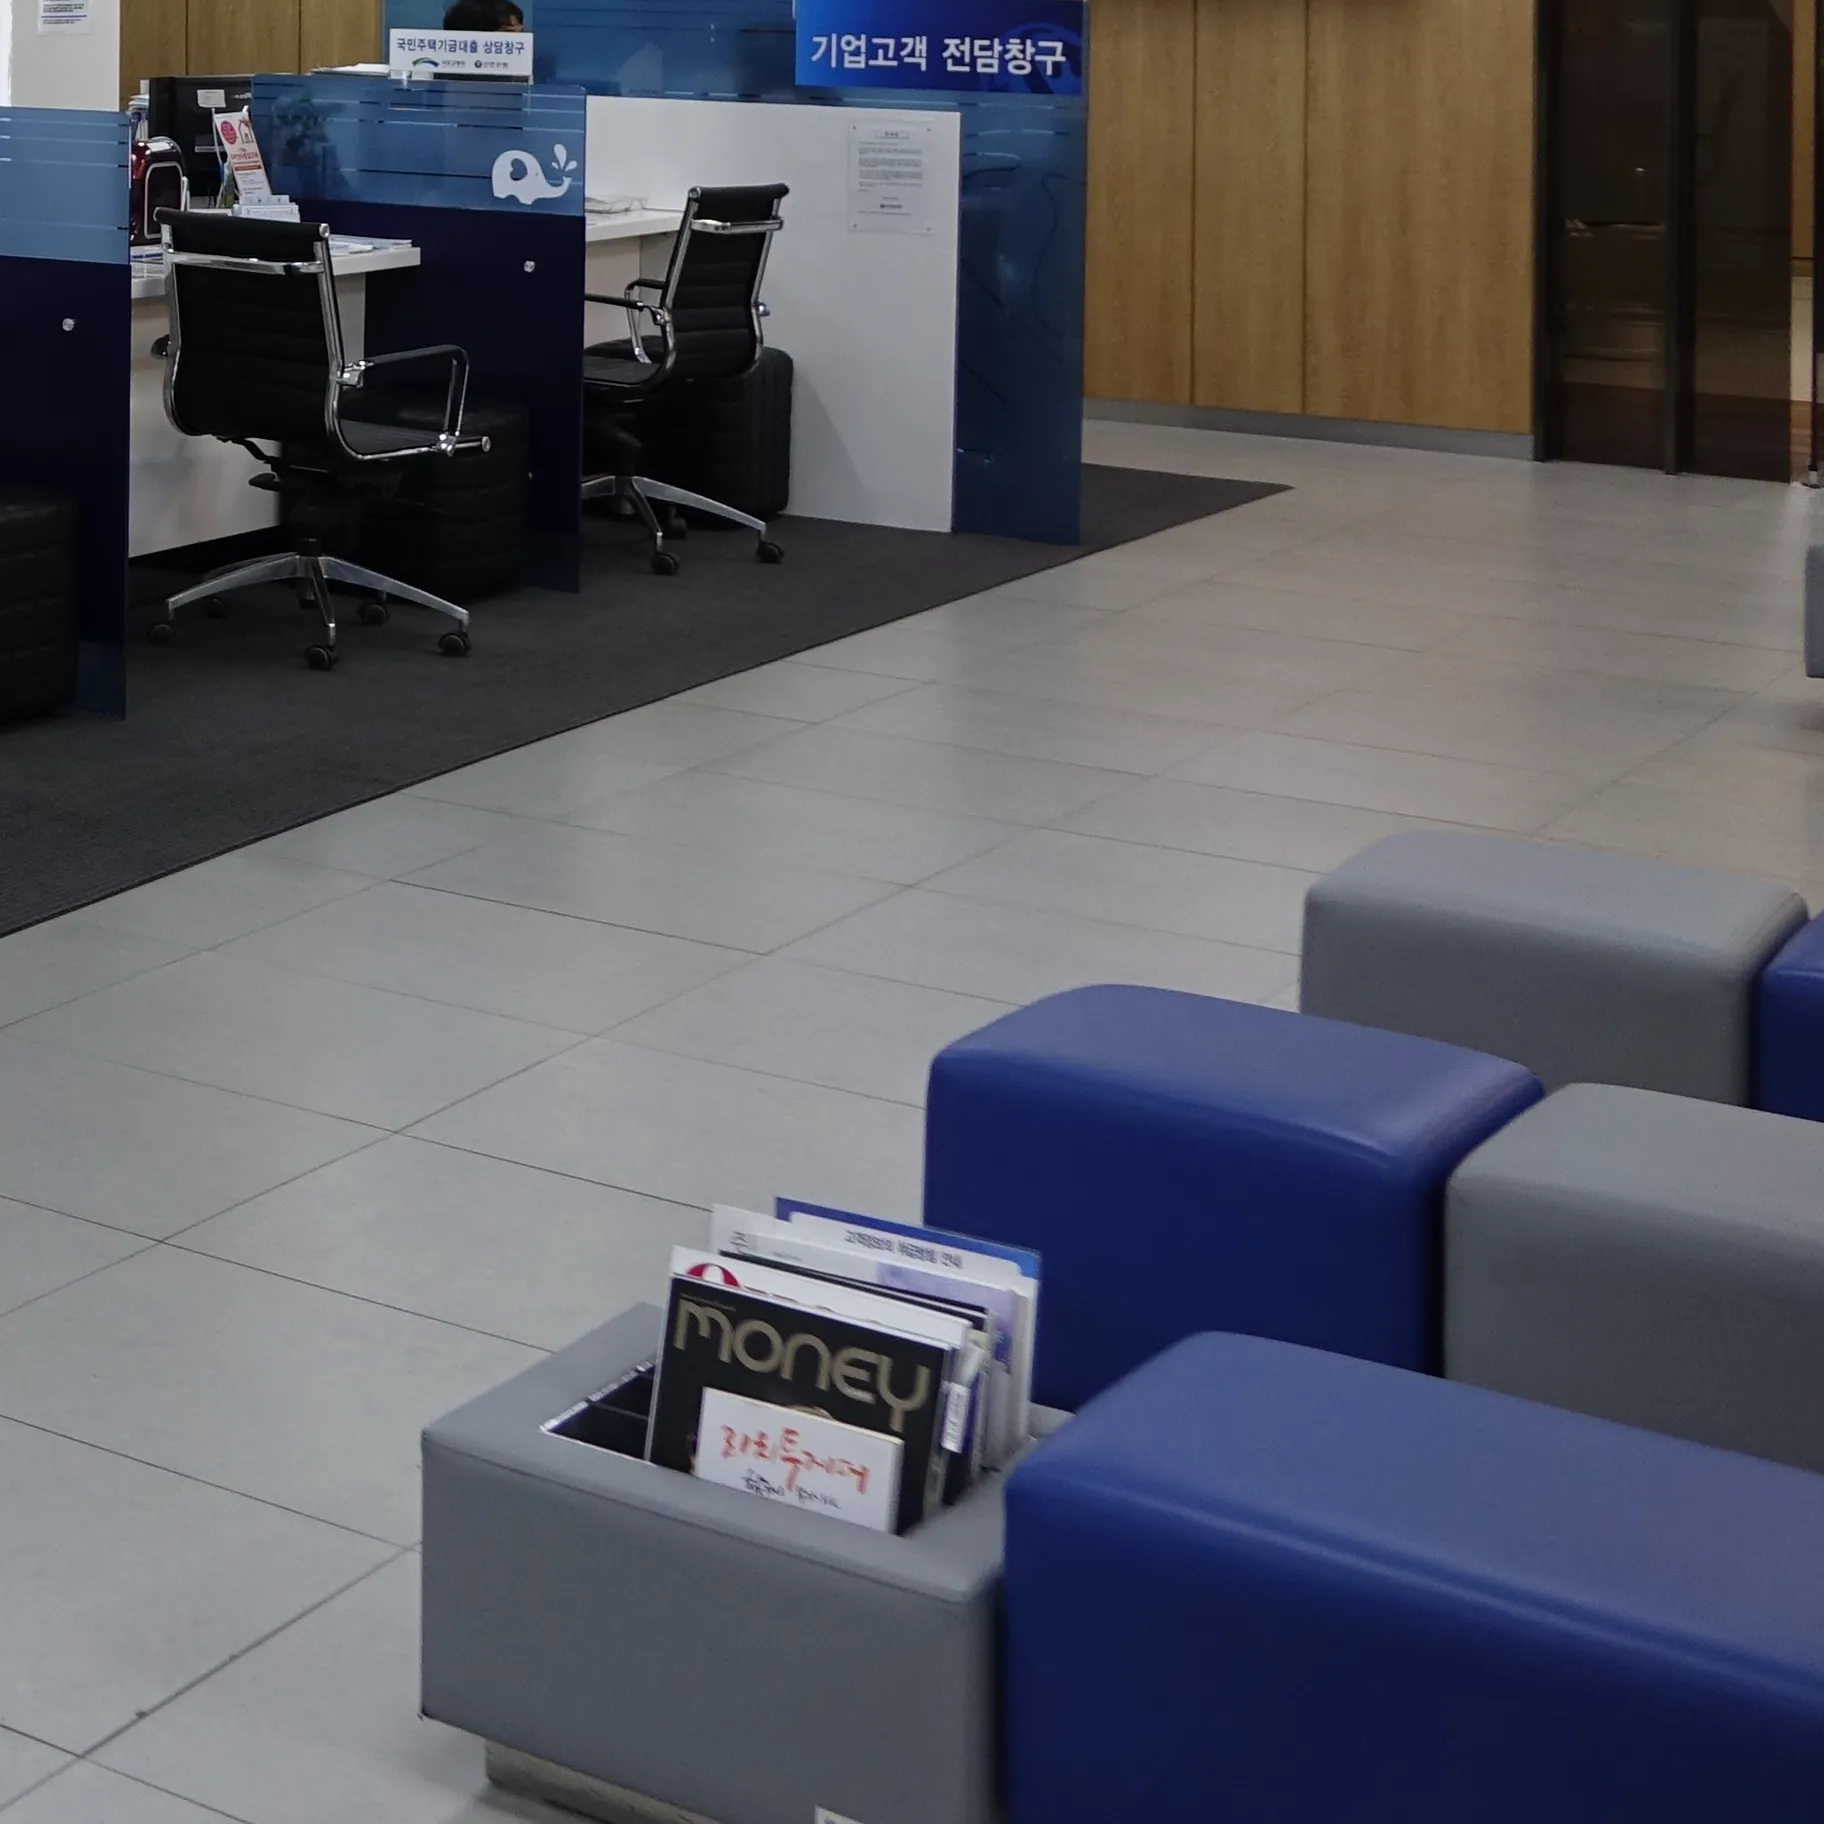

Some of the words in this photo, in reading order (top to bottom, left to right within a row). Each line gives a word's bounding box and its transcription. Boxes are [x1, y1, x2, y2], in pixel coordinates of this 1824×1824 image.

[396, 38, 478, 53] 국민주택기금대출
[482, 40, 526, 55] 상담창구
[810, 32, 928, 72] 기업고객
[942, 36, 1066, 76] 전담창구
